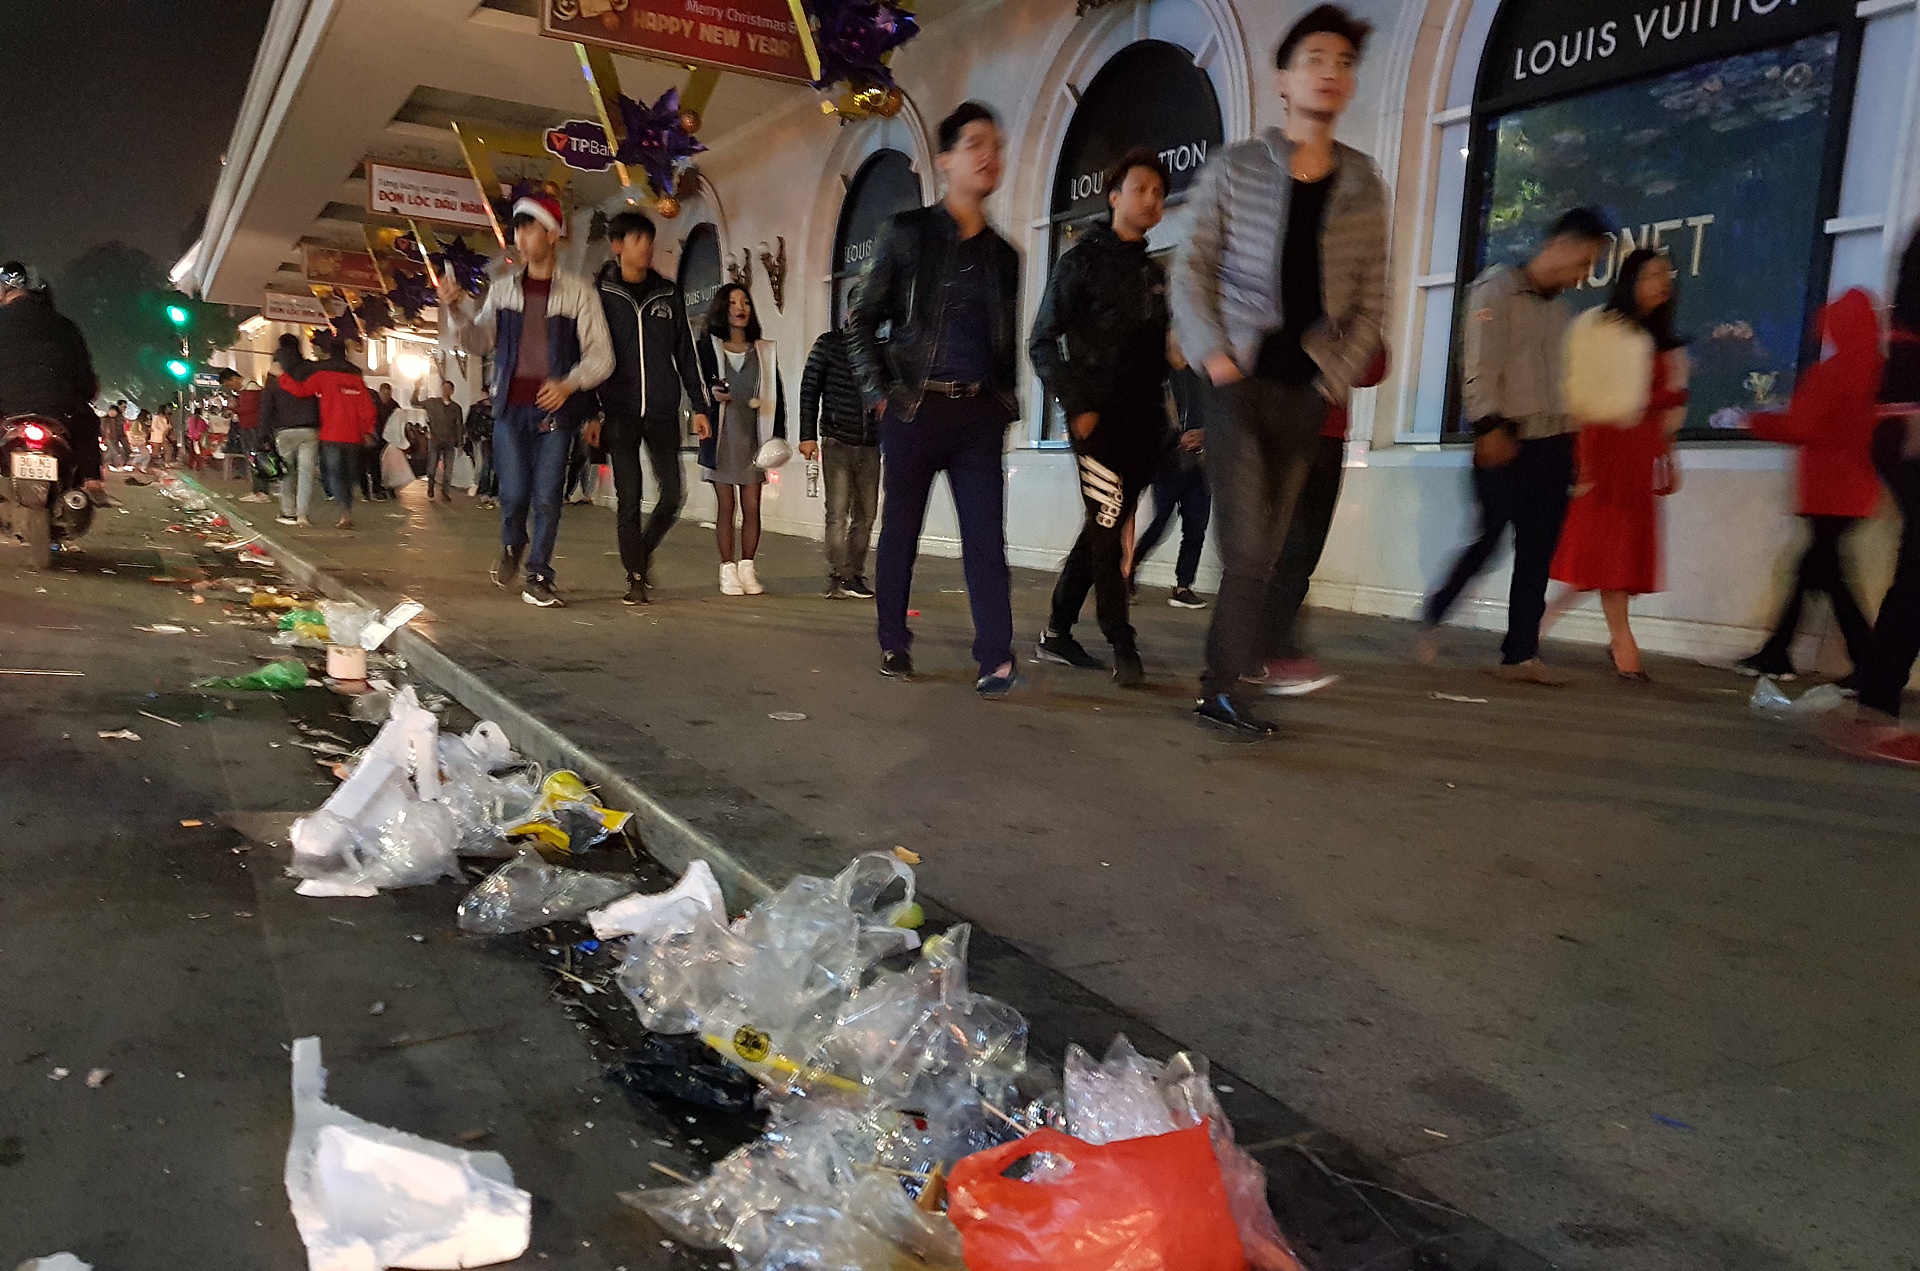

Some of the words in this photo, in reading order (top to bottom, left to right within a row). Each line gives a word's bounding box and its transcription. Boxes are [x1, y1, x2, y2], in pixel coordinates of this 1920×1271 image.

[633, 9, 695, 38] HAPPY
[699, 22, 741, 48] NEW
[686, 0, 723, 21] Merry
[727, 8, 787, 32] Christmas
[1514, 20, 1617, 80] LOUIS
[1634, 0, 1798, 48] VUITT
[1070, 171, 1104, 201] LOU
[1157, 139, 1208, 173] TTON
